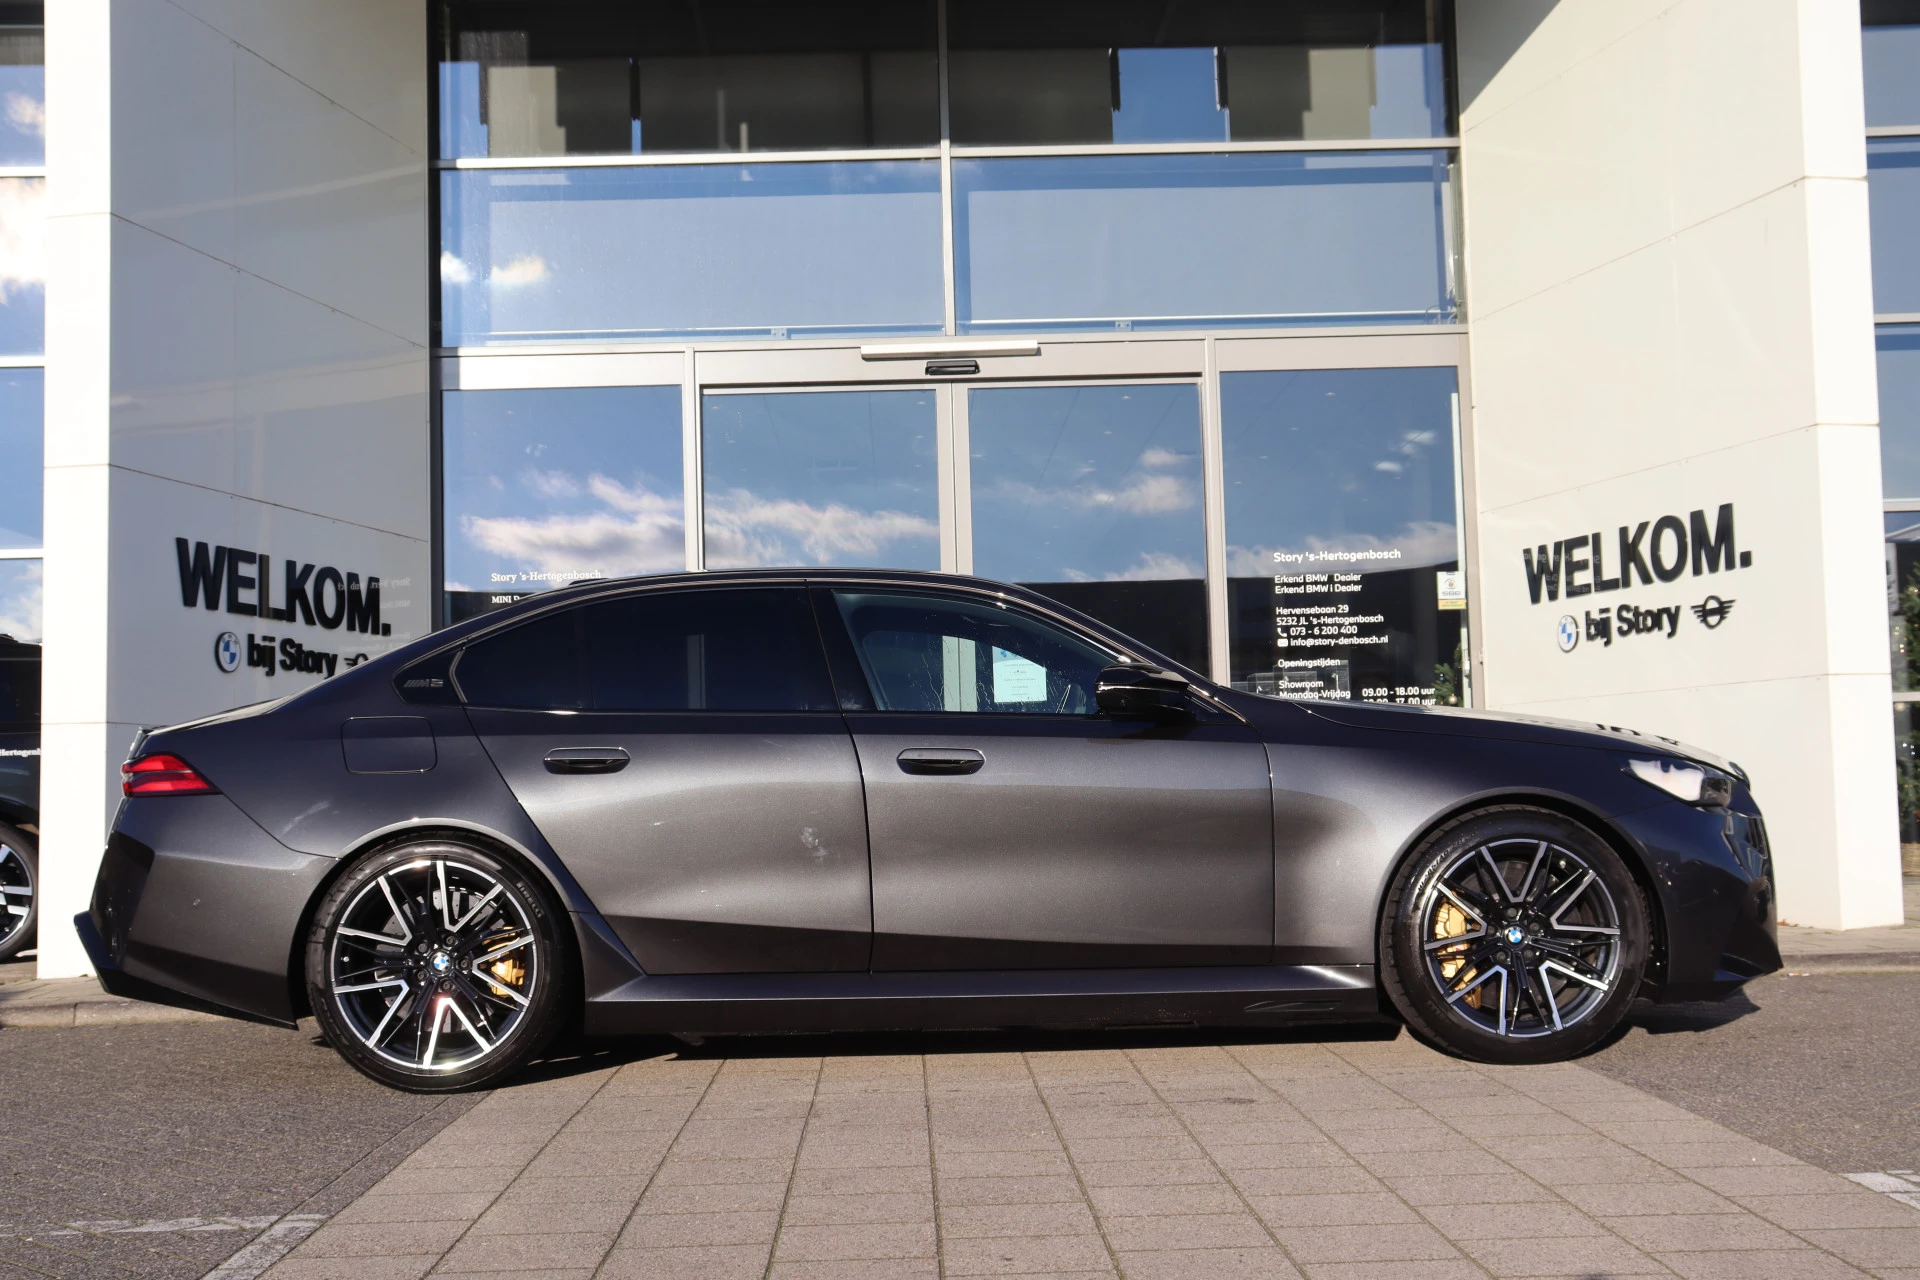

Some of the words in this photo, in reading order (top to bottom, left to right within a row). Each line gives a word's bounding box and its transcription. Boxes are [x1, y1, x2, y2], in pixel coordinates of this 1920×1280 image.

[1273, 552, 1303, 563] Story
[1306, 549, 1401, 562] 's-Hertogenbosch
[1522, 503, 1752, 605] WELKOM.
[491, 573, 517, 583] Story
[1274, 575, 1304, 583] Erkend
[1306, 573, 1328, 582] BMW
[1334, 573, 1361, 581] Dealer
[175, 537, 391, 637] WELKOM.
[1275, 585, 1304, 594] Erkend
[1306, 584, 1328, 593] BMW
[1330, 584, 1333, 592] i
[1335, 583, 1362, 592] Dealer
[1276, 606, 1336, 615] Hervensebaan
[1337, 604, 1349, 613] 29
[1276, 617, 1297, 625] 5232
[1298, 617, 1308, 625] JL
[1585, 607, 1611, 647] bij
[1617, 604, 1681, 638] Story
[1290, 627, 1306, 636] 073
[1314, 627, 1320, 635] 6
[1321, 626, 1338, 635] 200
[1340, 625, 1358, 634] 400
[1290, 635, 1389, 647] info@story-denbosch.nl
[247, 633, 276, 677] bij
[279, 637, 338, 680] Story
[1277, 658, 1340, 669] Openingstijden
[1278, 680, 1324, 689] Showroom
[1279, 689, 1351, 700] Maandag-Vrijdag
[1362, 688, 1388, 697] 09.00
[1395, 686, 1420, 696] 18.00
[1421, 687, 1436, 695] uur
[1395, 697, 1420, 705] 1700
[1421, 698, 1437, 706] uur
